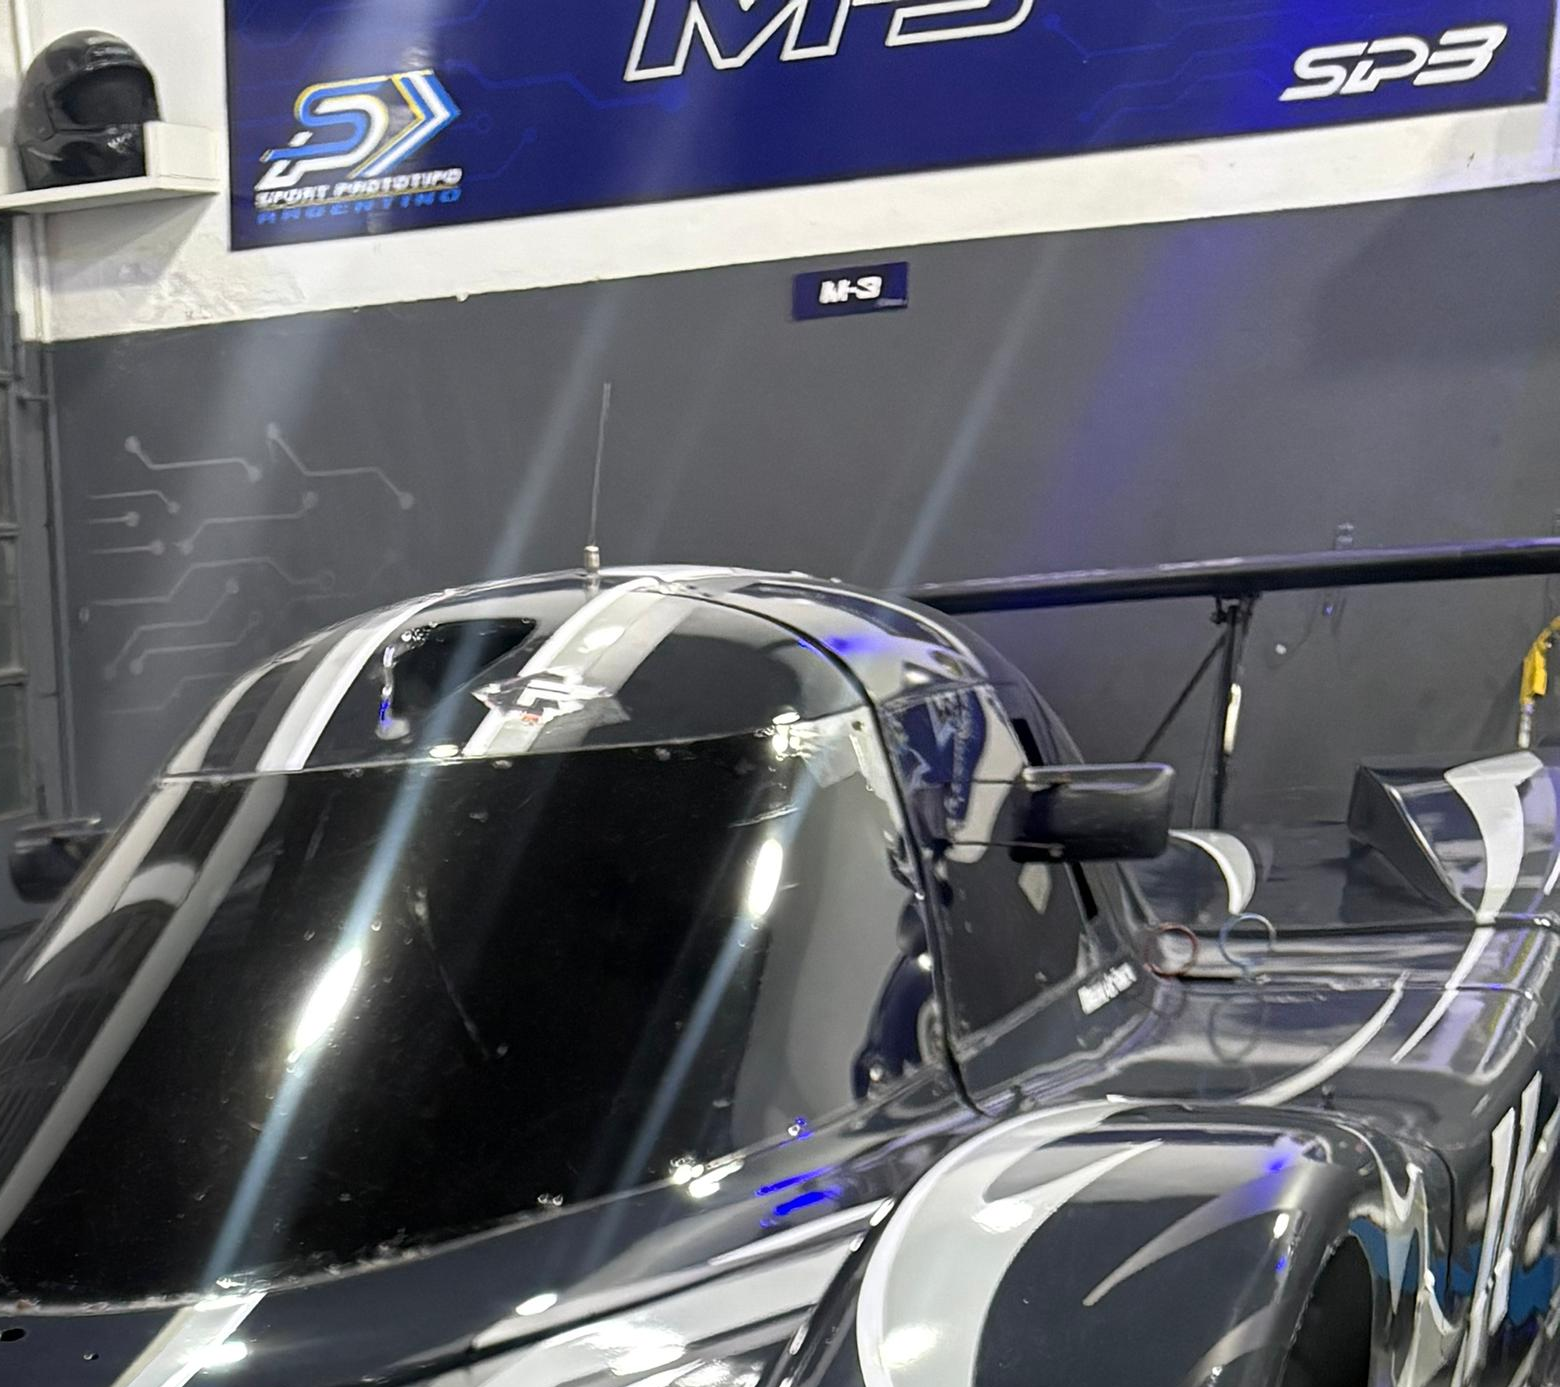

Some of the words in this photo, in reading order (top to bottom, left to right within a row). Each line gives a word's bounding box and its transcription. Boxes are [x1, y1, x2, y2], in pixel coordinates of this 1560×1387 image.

[1279, 24, 1508, 101] SP3
[254, 184, 331, 208] SPORT
[332, 168, 463, 198] PROTOTIPO
[255, 188, 462, 225] ARGENTINO
